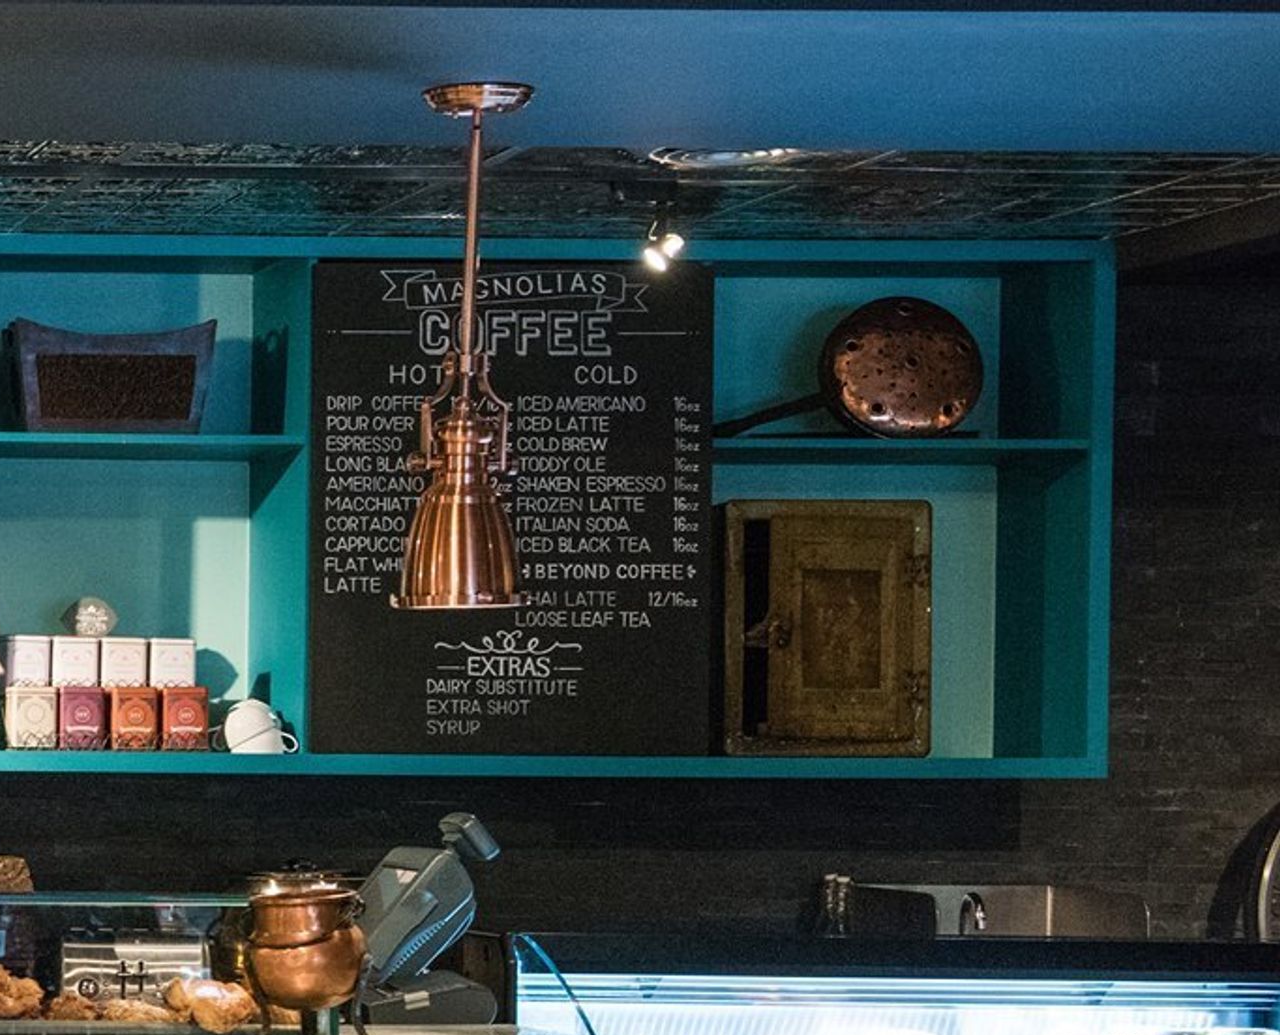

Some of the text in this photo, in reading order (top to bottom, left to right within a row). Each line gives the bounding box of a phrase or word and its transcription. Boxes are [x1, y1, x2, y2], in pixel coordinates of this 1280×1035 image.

[422, 273, 608, 305] MAGNOLIAS
[418, 309, 613, 357] COFFEE
[388, 364, 445, 385] HOT
[574, 364, 639, 385] COLD
[327, 396, 363, 412] DRIP
[517, 396, 553, 412] ICED
[555, 396, 647, 412] AMERICANO
[327, 416, 415, 431] POUR OVER
[517, 416, 553, 432] ICED
[555, 416, 611, 432] LATTE
[326, 436, 403, 452] ESPRESSO
[516, 436, 560, 452] COLD
[562, 436, 609, 452] BREW
[325, 456, 406, 472] LONG BLA
[518, 456, 569, 472] TODDY
[574, 456, 606, 472] OLE
[326, 476, 424, 493] AMERICANO
[516, 476, 581, 493] SHAKEN
[585, 476, 666, 493] ESPRESSO
[325, 496, 421, 512] MACCHIATT
[516, 496, 585, 513] FROZEN
[589, 496, 646, 513] LATTE
[325, 516, 406, 532] CORTADO
[516, 516, 581, 533] ITALIAN
[585, 516, 631, 533] SODA
[515, 536, 553, 553] ICED
[556, 536, 612, 553] BLACK
[616, 536, 652, 553] TEA
[324, 556, 403, 573] FLAT WHI
[534, 563, 684, 581] BEYOND COFFEE
[324, 577, 383, 594] LATTE
[564, 590, 617, 608] LATTE
[514, 611, 652, 628] LOOSE LEAF TEA
[467, 657, 551, 678] EXTRAS
[426, 679, 577, 697] DAIRY SUBSTITUTE
[426, 699, 531, 717] EXTRA SHOT
[426, 719, 481, 736] SYRUP
